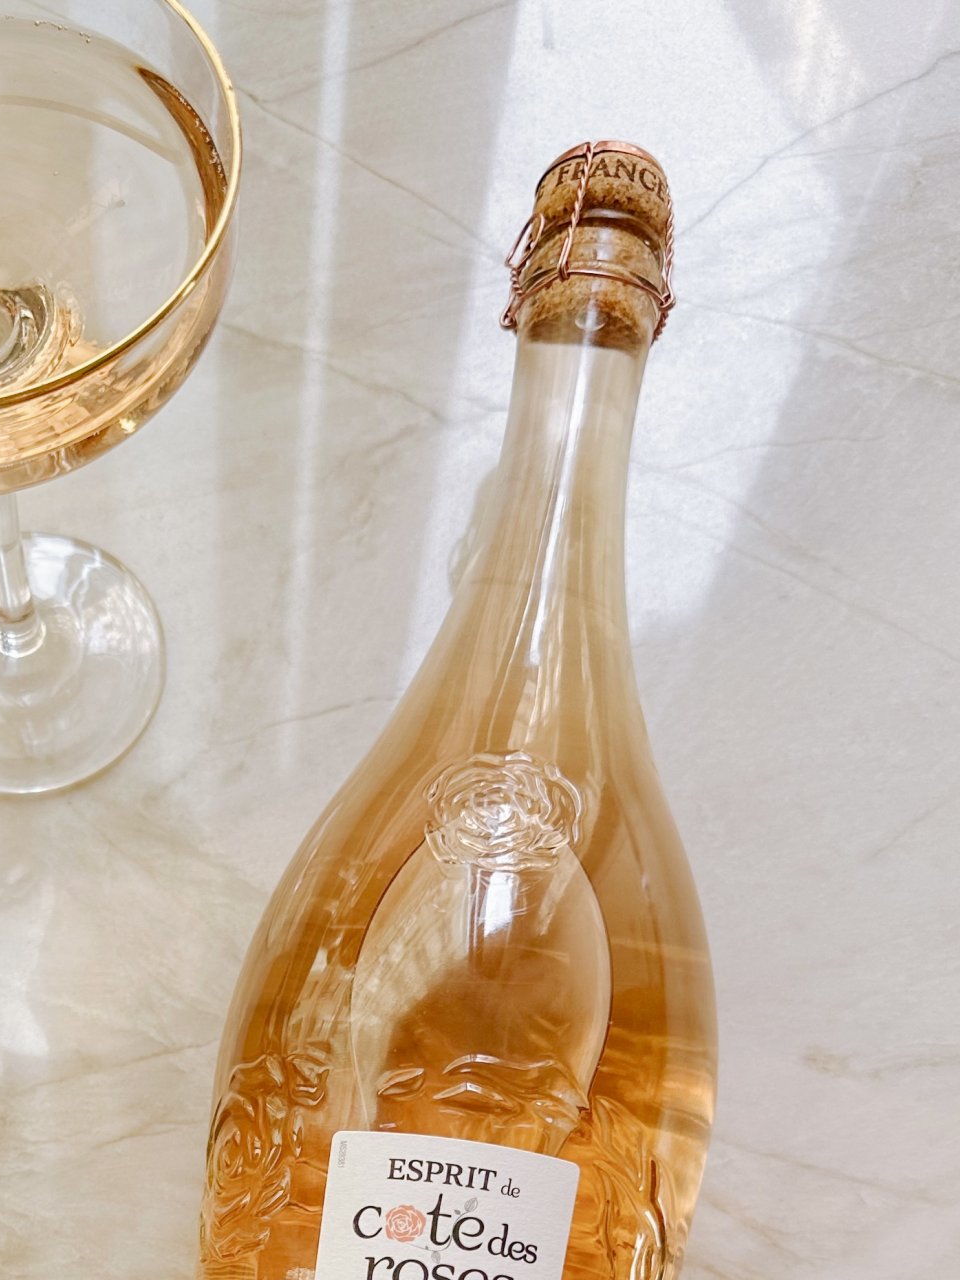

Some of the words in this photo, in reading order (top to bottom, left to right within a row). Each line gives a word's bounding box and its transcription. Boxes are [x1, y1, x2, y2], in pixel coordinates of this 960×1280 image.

[387, 1158, 497, 1192] ESPRIT
[500, 1178, 521, 1198] de
[487, 1224, 538, 1264] des
